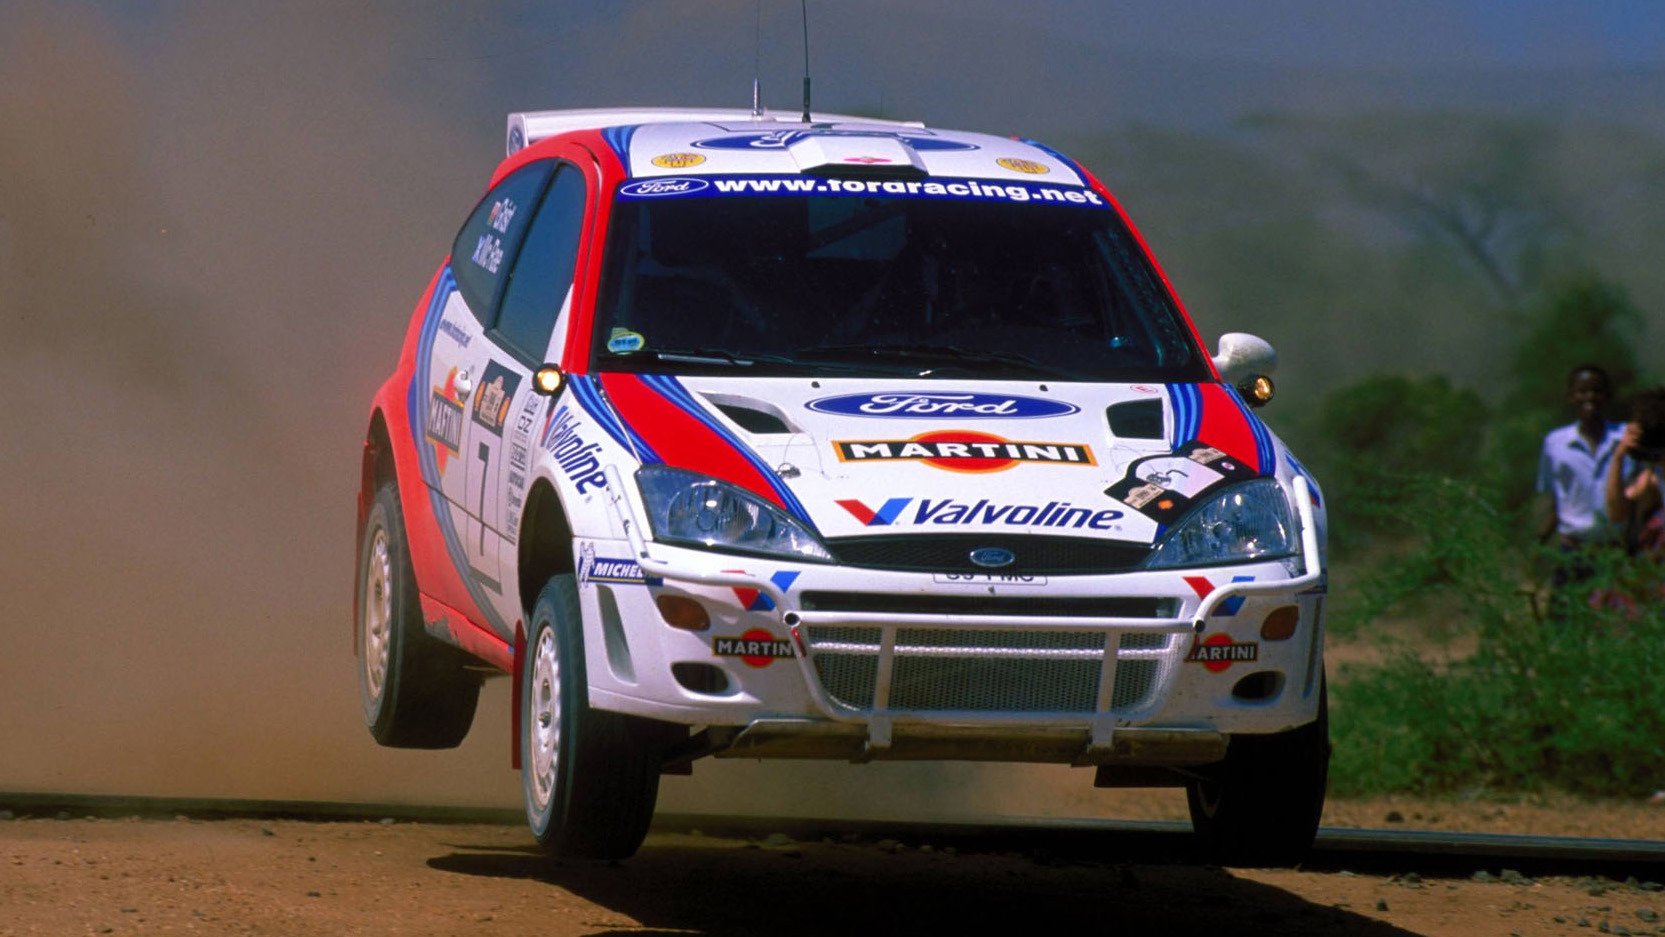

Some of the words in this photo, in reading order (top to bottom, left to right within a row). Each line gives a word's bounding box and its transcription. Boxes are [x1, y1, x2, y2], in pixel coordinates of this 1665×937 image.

[636, 180, 690, 193] Ford
[859, 394, 1018, 414] Ford
[546, 411, 608, 495] Valvoline
[850, 443, 1080, 461] MARTINI
[914, 499, 1124, 530] Valvoline
[593, 562, 644, 578] MICHEL
[718, 640, 793, 656] MARTIN
[1191, 645, 1256, 660] ARTINI
